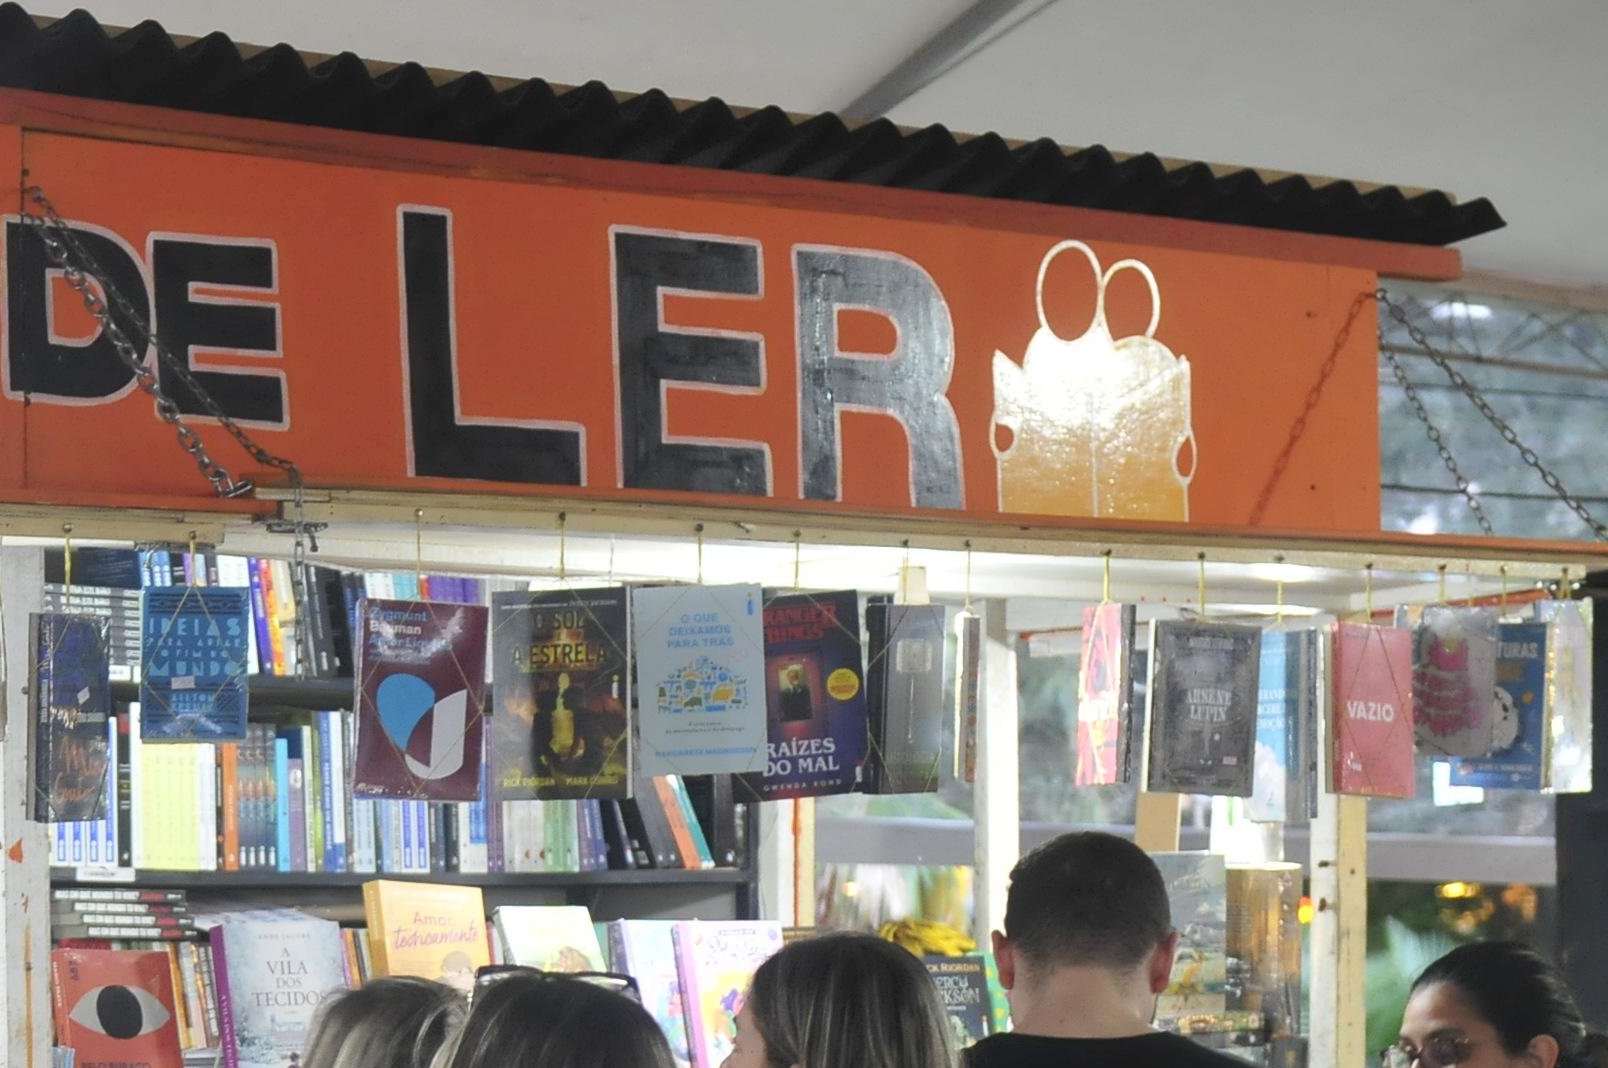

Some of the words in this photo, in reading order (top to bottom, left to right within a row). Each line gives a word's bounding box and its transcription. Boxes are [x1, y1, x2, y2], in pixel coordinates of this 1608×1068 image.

[0, 212, 290, 431] DE
[395, 202, 967, 509] LER
[1346, 701, 1395, 724] VAZIO
[766, 737, 836, 758] RAÍZES
[798, 754, 840, 774] MAL
[280, 947, 291, 958] A
[267, 961, 309, 976] VILA
[276, 976, 303, 989] DOS
[251, 990, 328, 1008] TECIDOS
